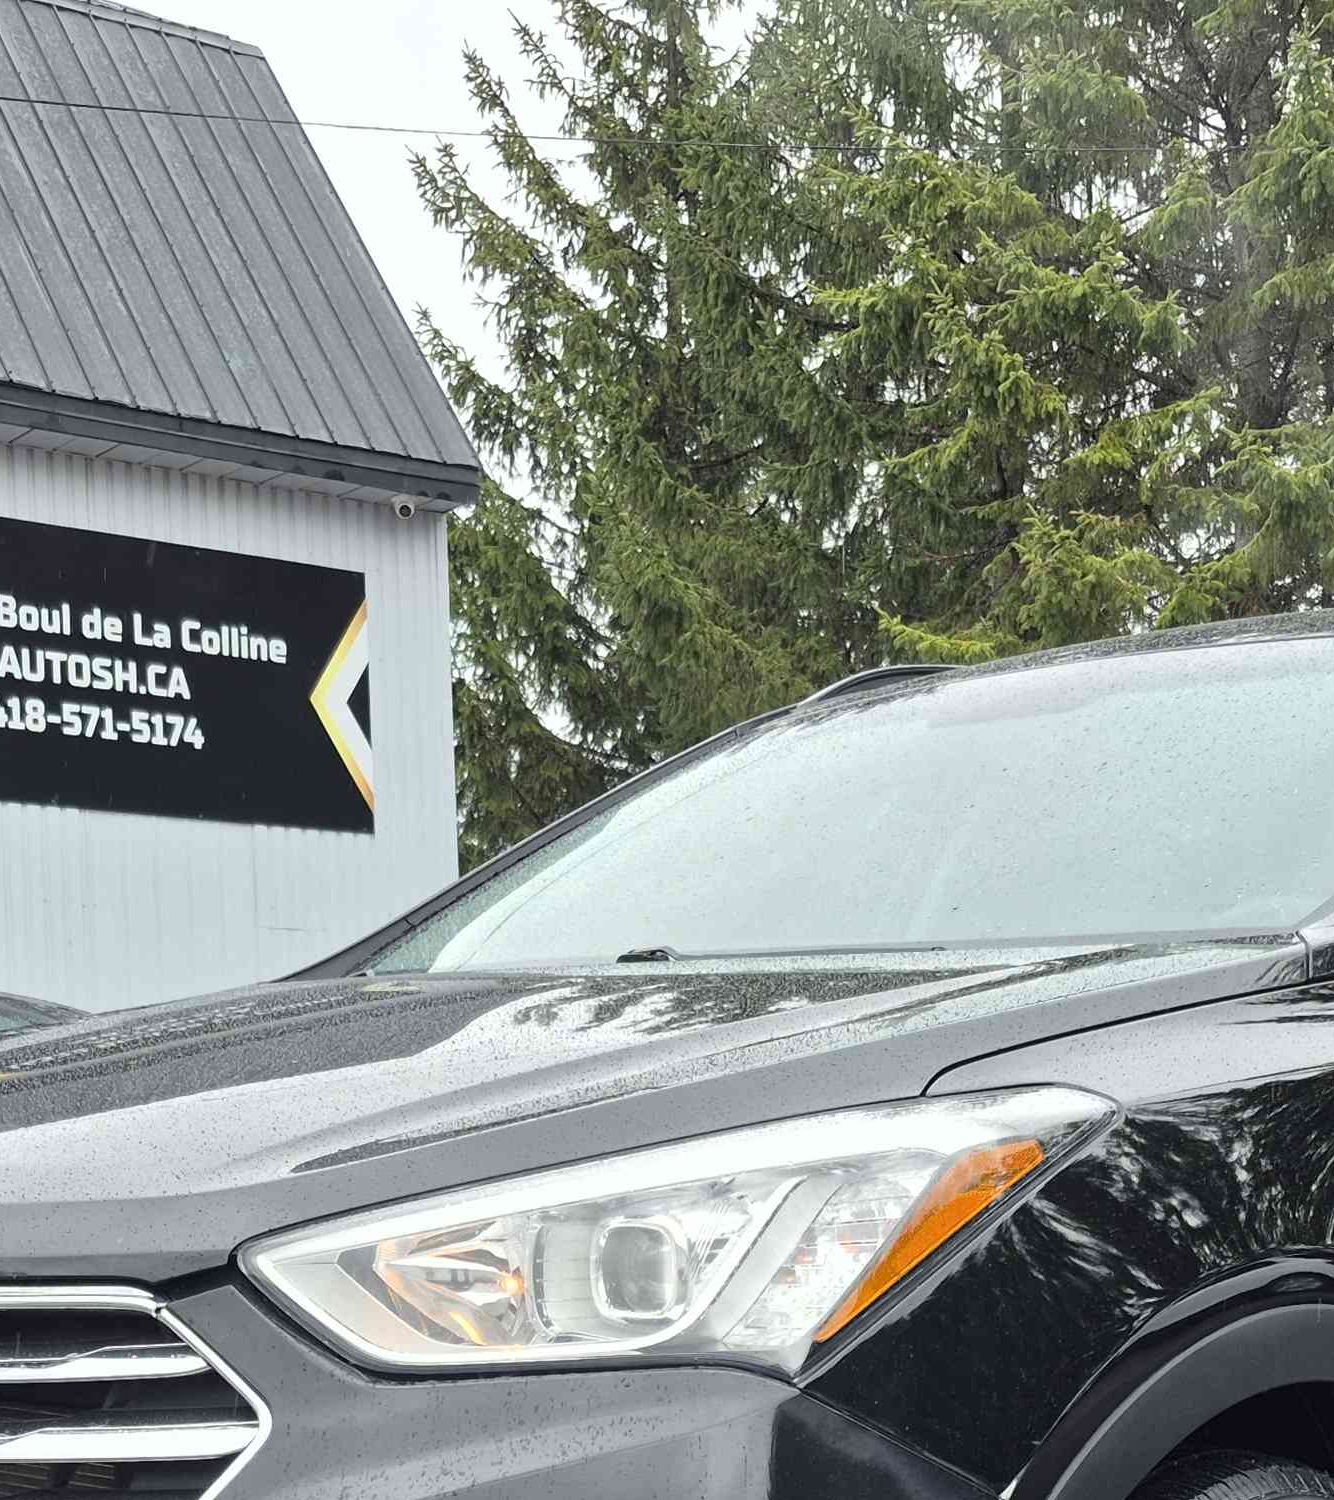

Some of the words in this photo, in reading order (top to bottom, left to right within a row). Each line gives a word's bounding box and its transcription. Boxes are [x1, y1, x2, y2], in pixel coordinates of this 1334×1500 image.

[81, 607, 123, 643] de
[132, 612, 172, 649] La
[180, 618, 288, 665] Colline
